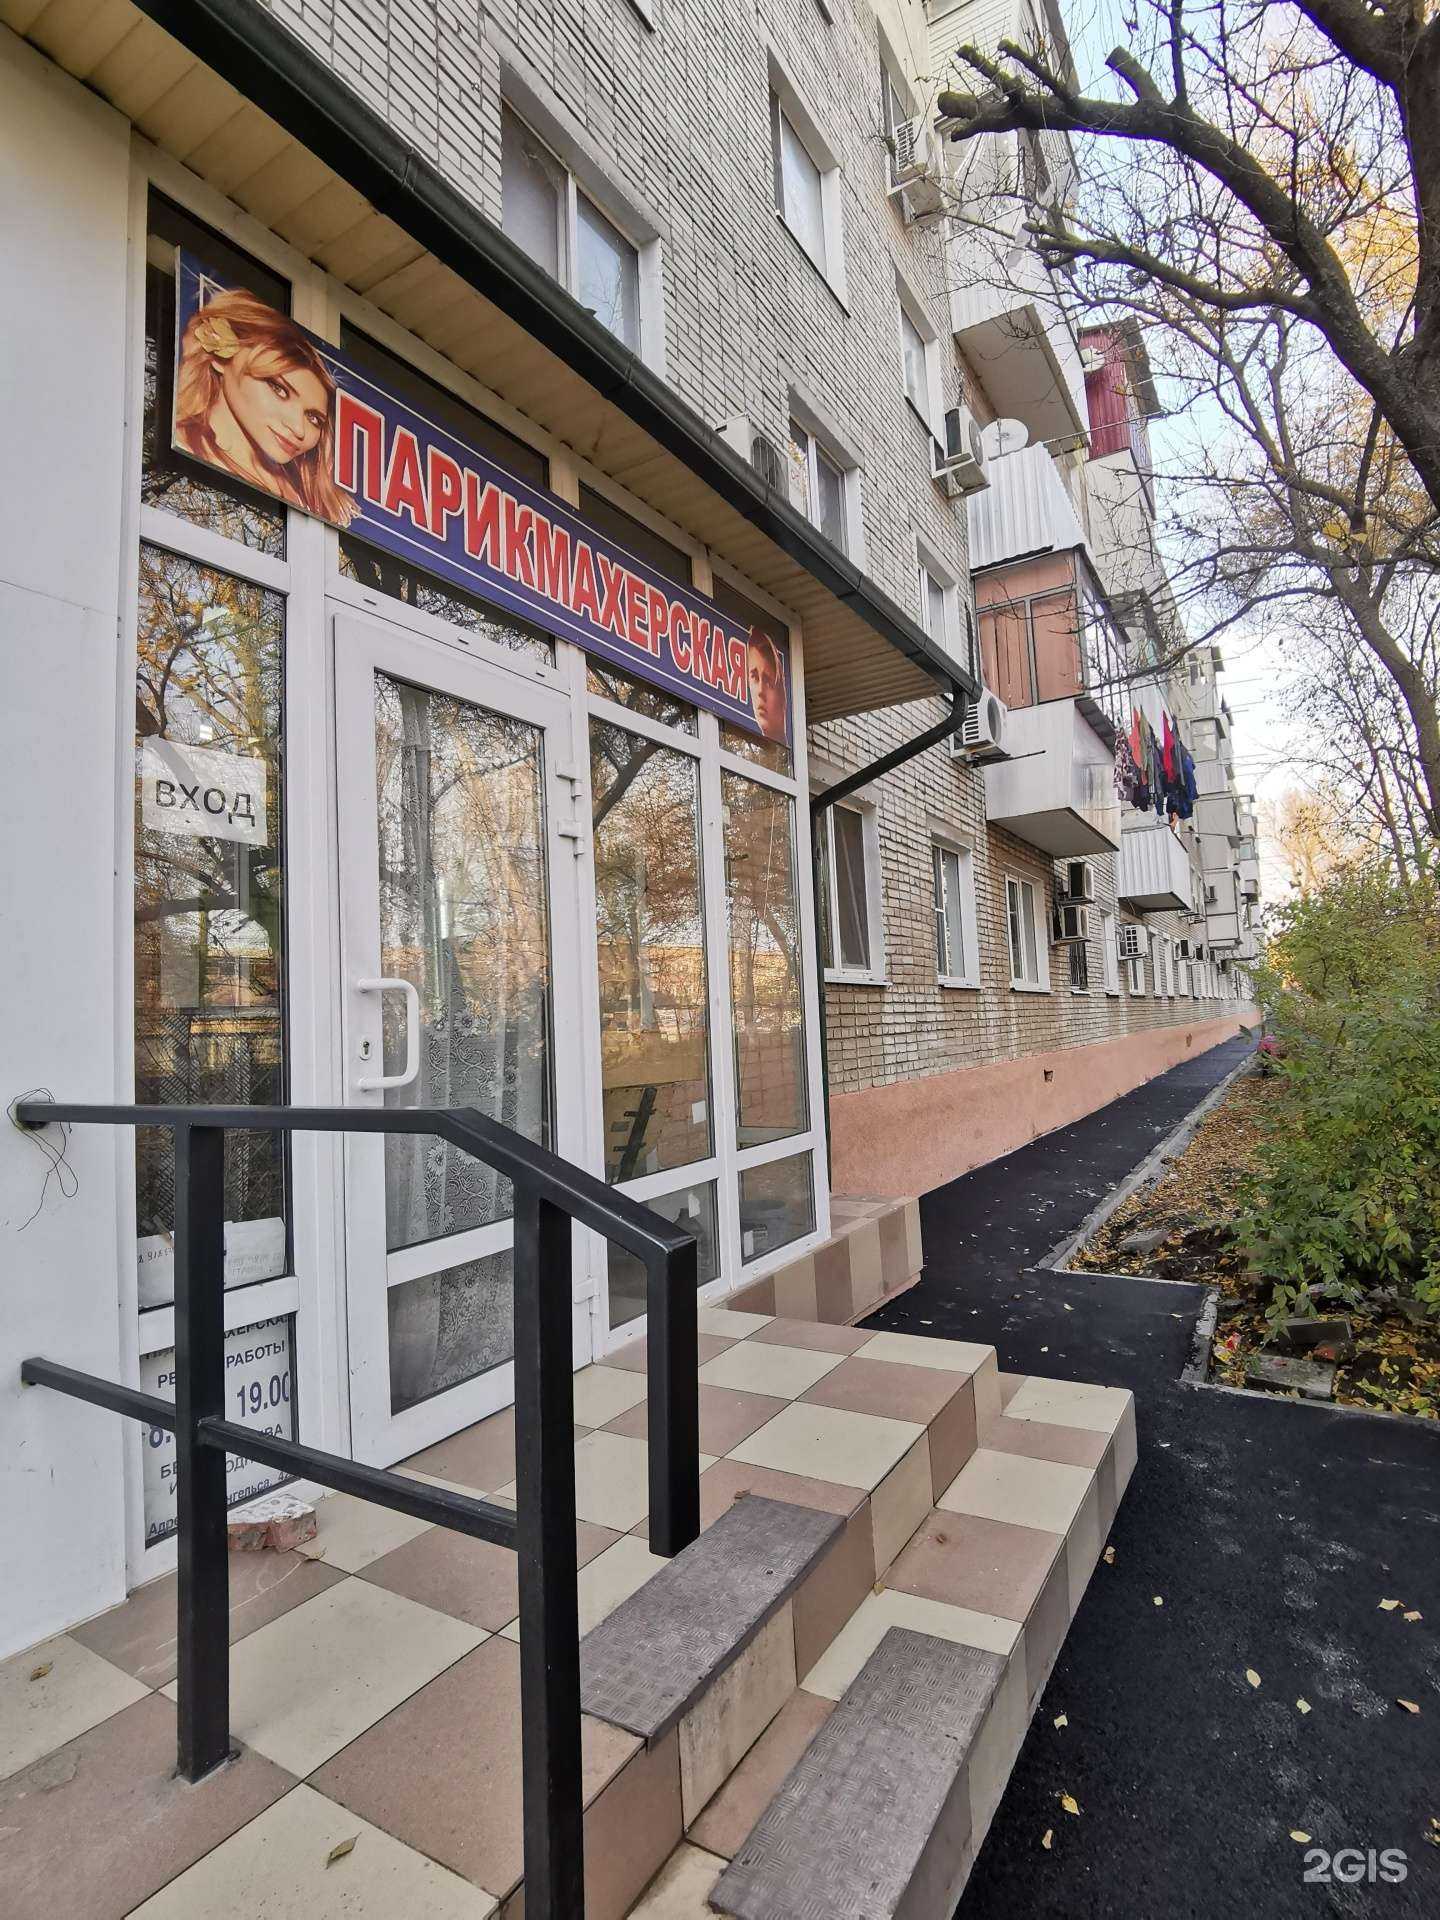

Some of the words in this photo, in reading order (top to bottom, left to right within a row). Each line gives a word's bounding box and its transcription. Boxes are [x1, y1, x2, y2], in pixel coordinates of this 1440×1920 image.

[334, 388, 749, 704] ПАРИКМАХЕРСКАЯ
[155, 779, 256, 827] ВХОД
[226, 1340, 285, 1369] РАБОТЫ
[236, 1371, 291, 1417] 19.00
[226, 1478, 273, 1505] нгельса,
